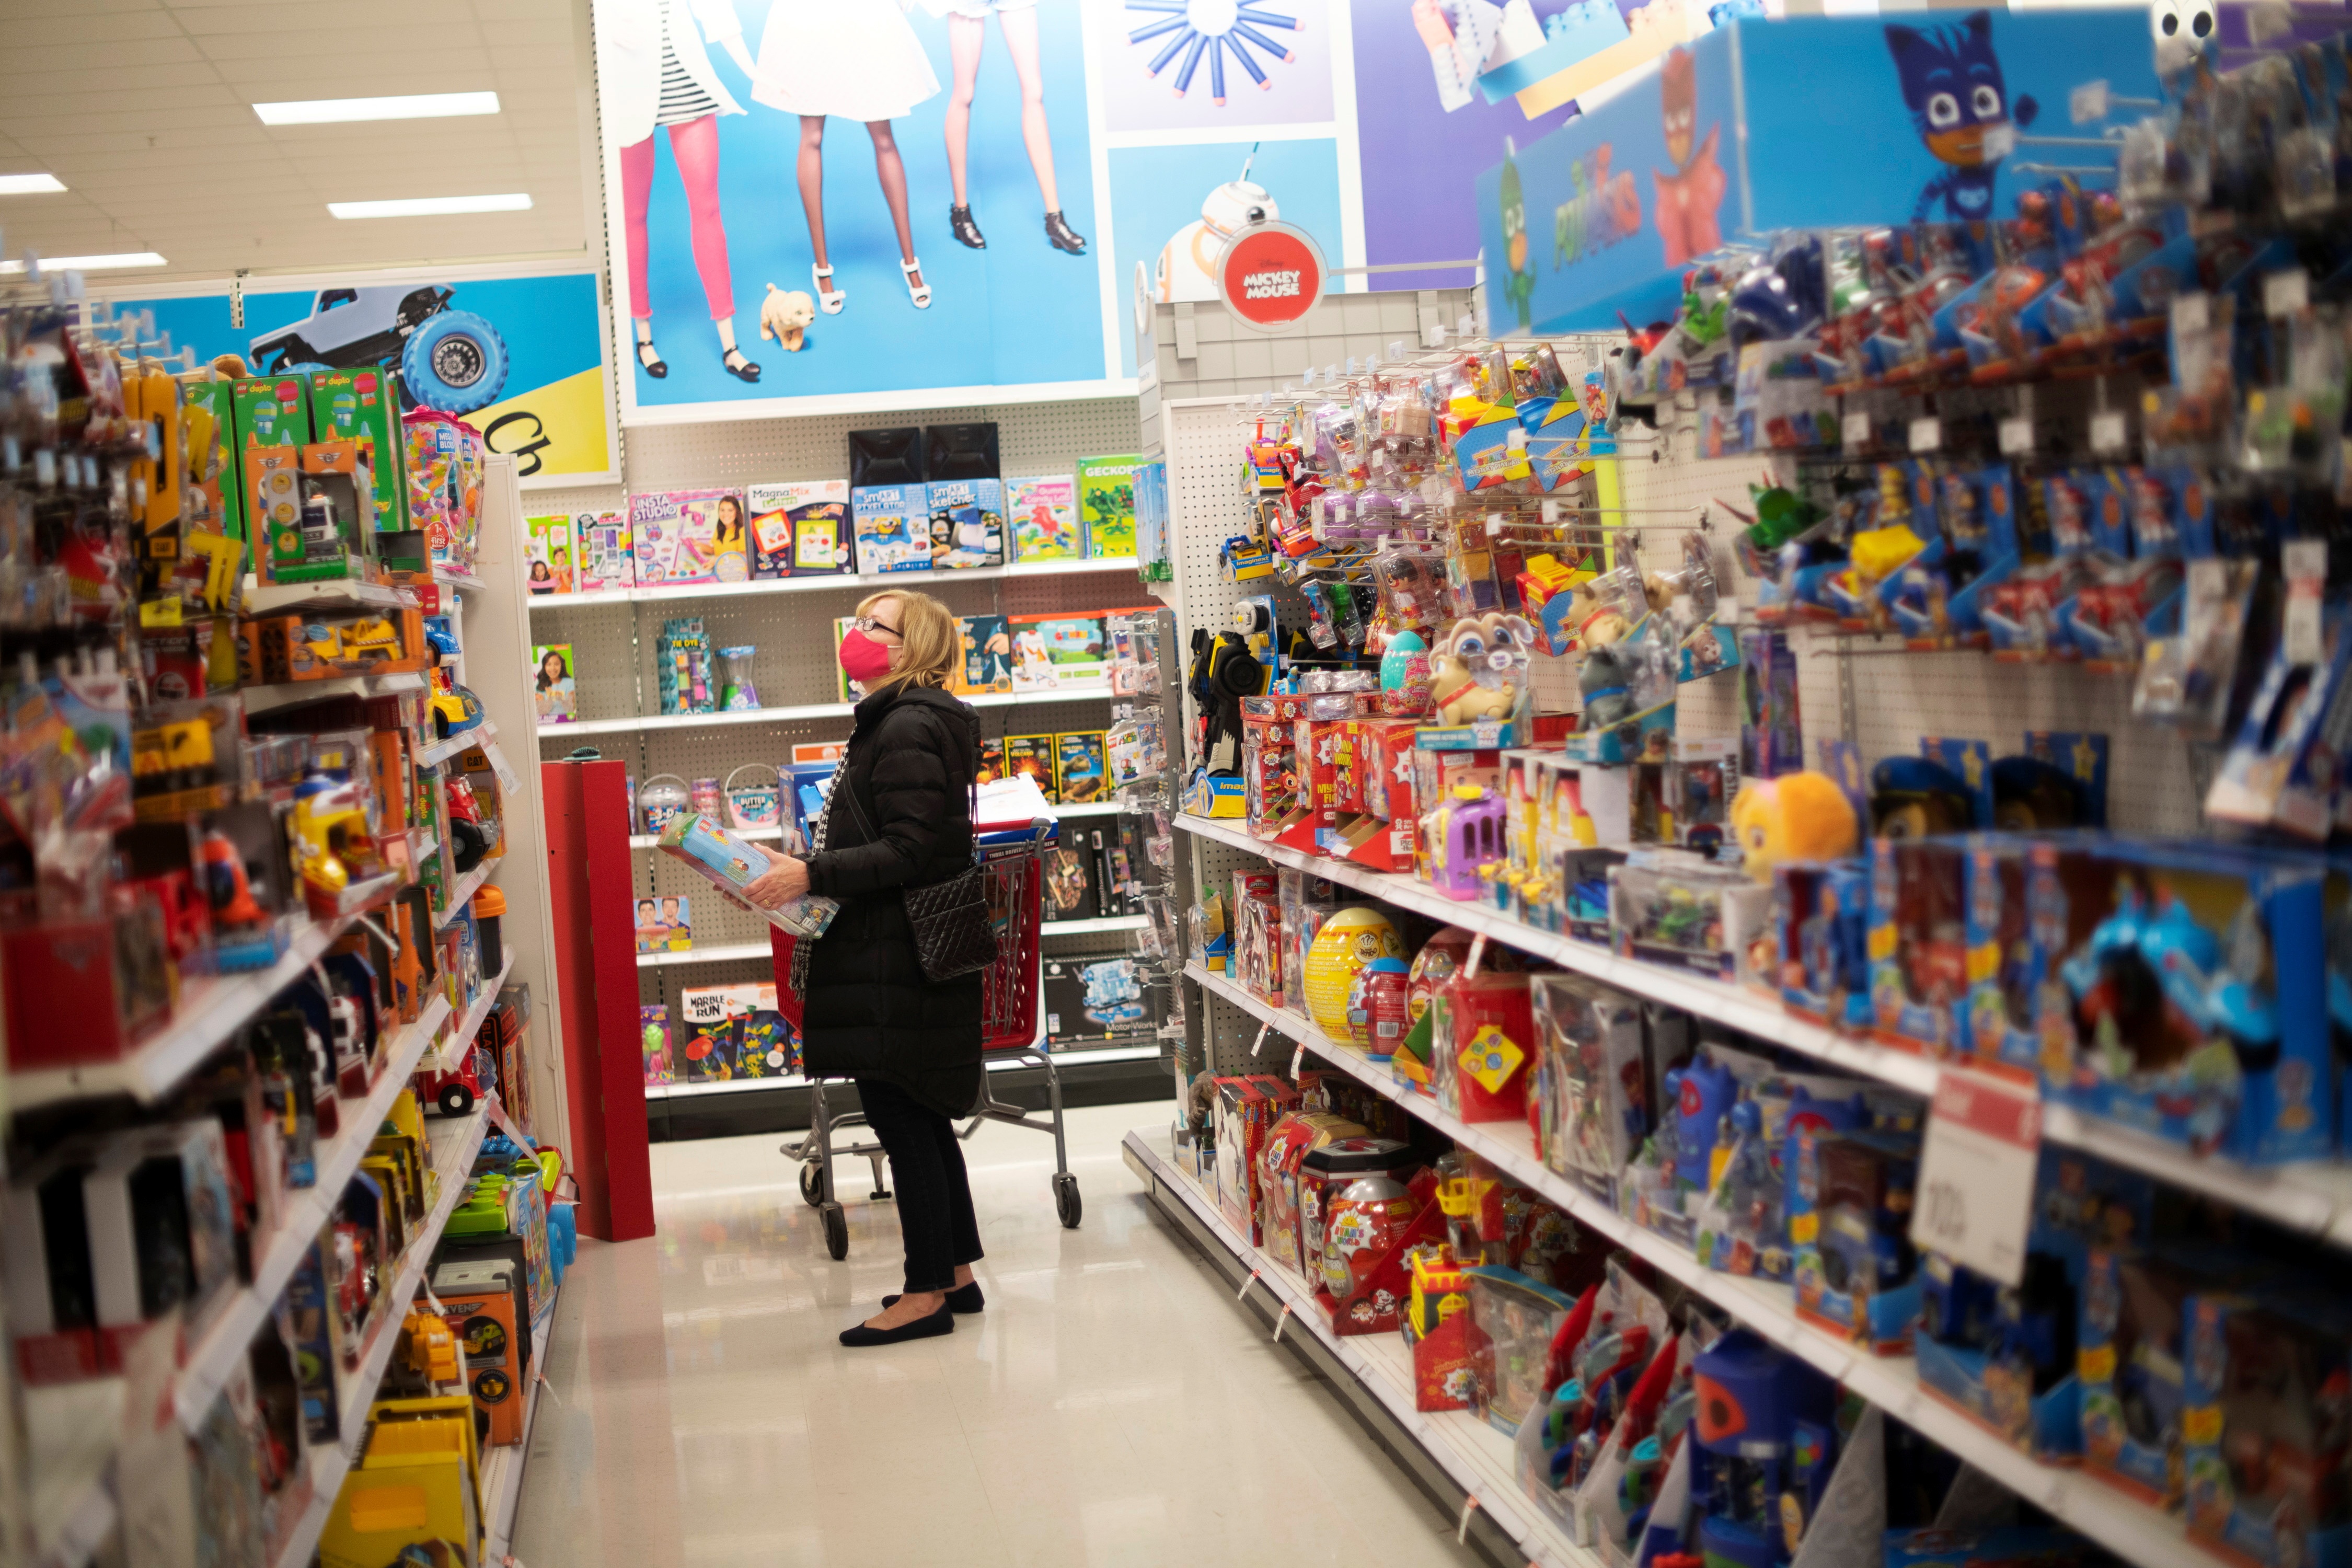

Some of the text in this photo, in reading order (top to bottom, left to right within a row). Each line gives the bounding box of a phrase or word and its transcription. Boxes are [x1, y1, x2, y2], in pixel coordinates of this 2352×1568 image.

[1243, 270, 1300, 287] MICKEY
[1246, 283, 1300, 299] MOUSE
[328, 376, 350, 386] duplo
[249, 384, 272, 393] duplo
[439, 432, 453, 441] MEGA
[1086, 464, 1148, 477] GECKOB
[1467, 463, 1495, 477] MYSTERY
[753, 488, 810, 500] MagnaMix
[863, 489, 900, 503] smART
[932, 483, 969, 497] smART
[1039, 486, 1070, 497] Gummy
[636, 494, 670, 510] INSTA
[763, 497, 798, 508] Letters
[929, 493, 976, 509] sketcher
[1025, 492, 1071, 504] Candy Lab
[633, 504, 678, 522] STUDIO
[1236, 556, 1270, 566] imaginext
[1554, 628, 1581, 642] MYSTERY
[672, 639, 698, 648] TIE DYE
[467, 755, 483, 767] CAT
[1334, 753, 1353, 769] WARRIORS
[740, 796, 766, 805] BUTTER
[419, 797, 428, 819] duplo
[709, 830, 729, 846] duplo
[988, 851, 1005, 859] THRILL
[1097, 858, 1108, 908] Smithsonian
[1360, 948, 1377, 957] TATTOO
[690, 995, 725, 1008] MARBLE
[696, 1005, 721, 1018] RUN
[1334, 1226, 1364, 1238] RYAN'S
[1337, 1236, 1361, 1246] WORLD
